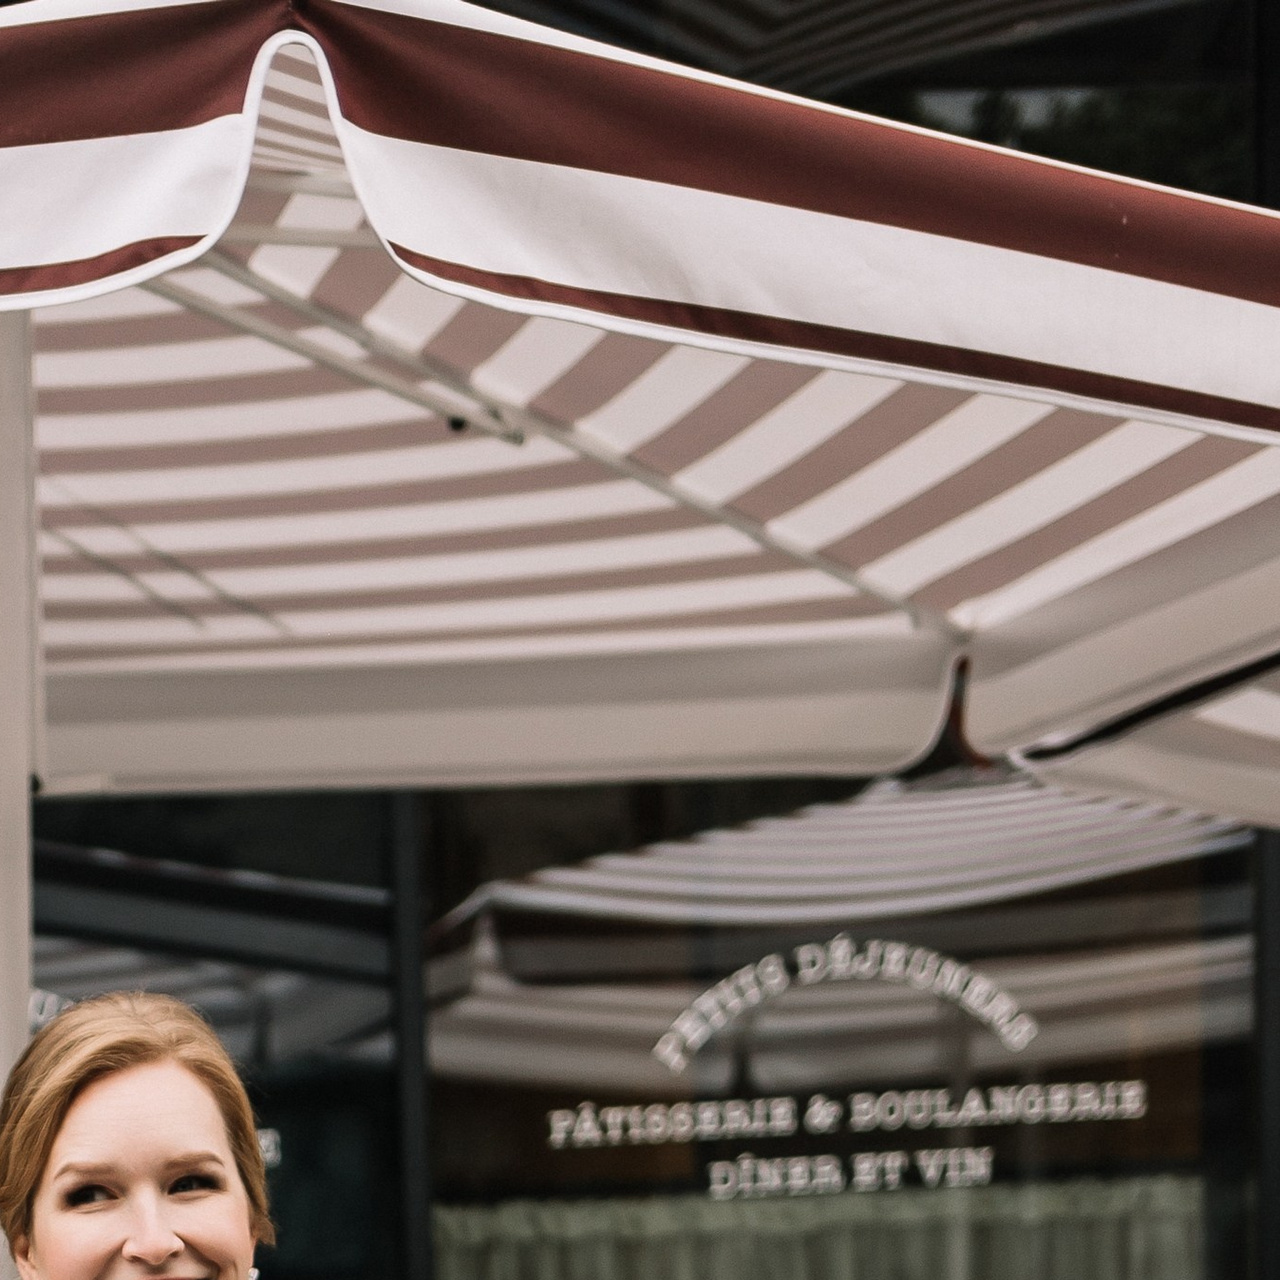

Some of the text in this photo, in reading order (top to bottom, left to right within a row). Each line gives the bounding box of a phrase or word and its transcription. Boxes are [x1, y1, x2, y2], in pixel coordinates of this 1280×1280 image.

[652, 953, 790, 1073] PETITS
[547, 1080, 1148, 1149] PÂTISSERIE & BOULANGERIE
[708, 1146, 994, 1199] DÎNER ET VIN
